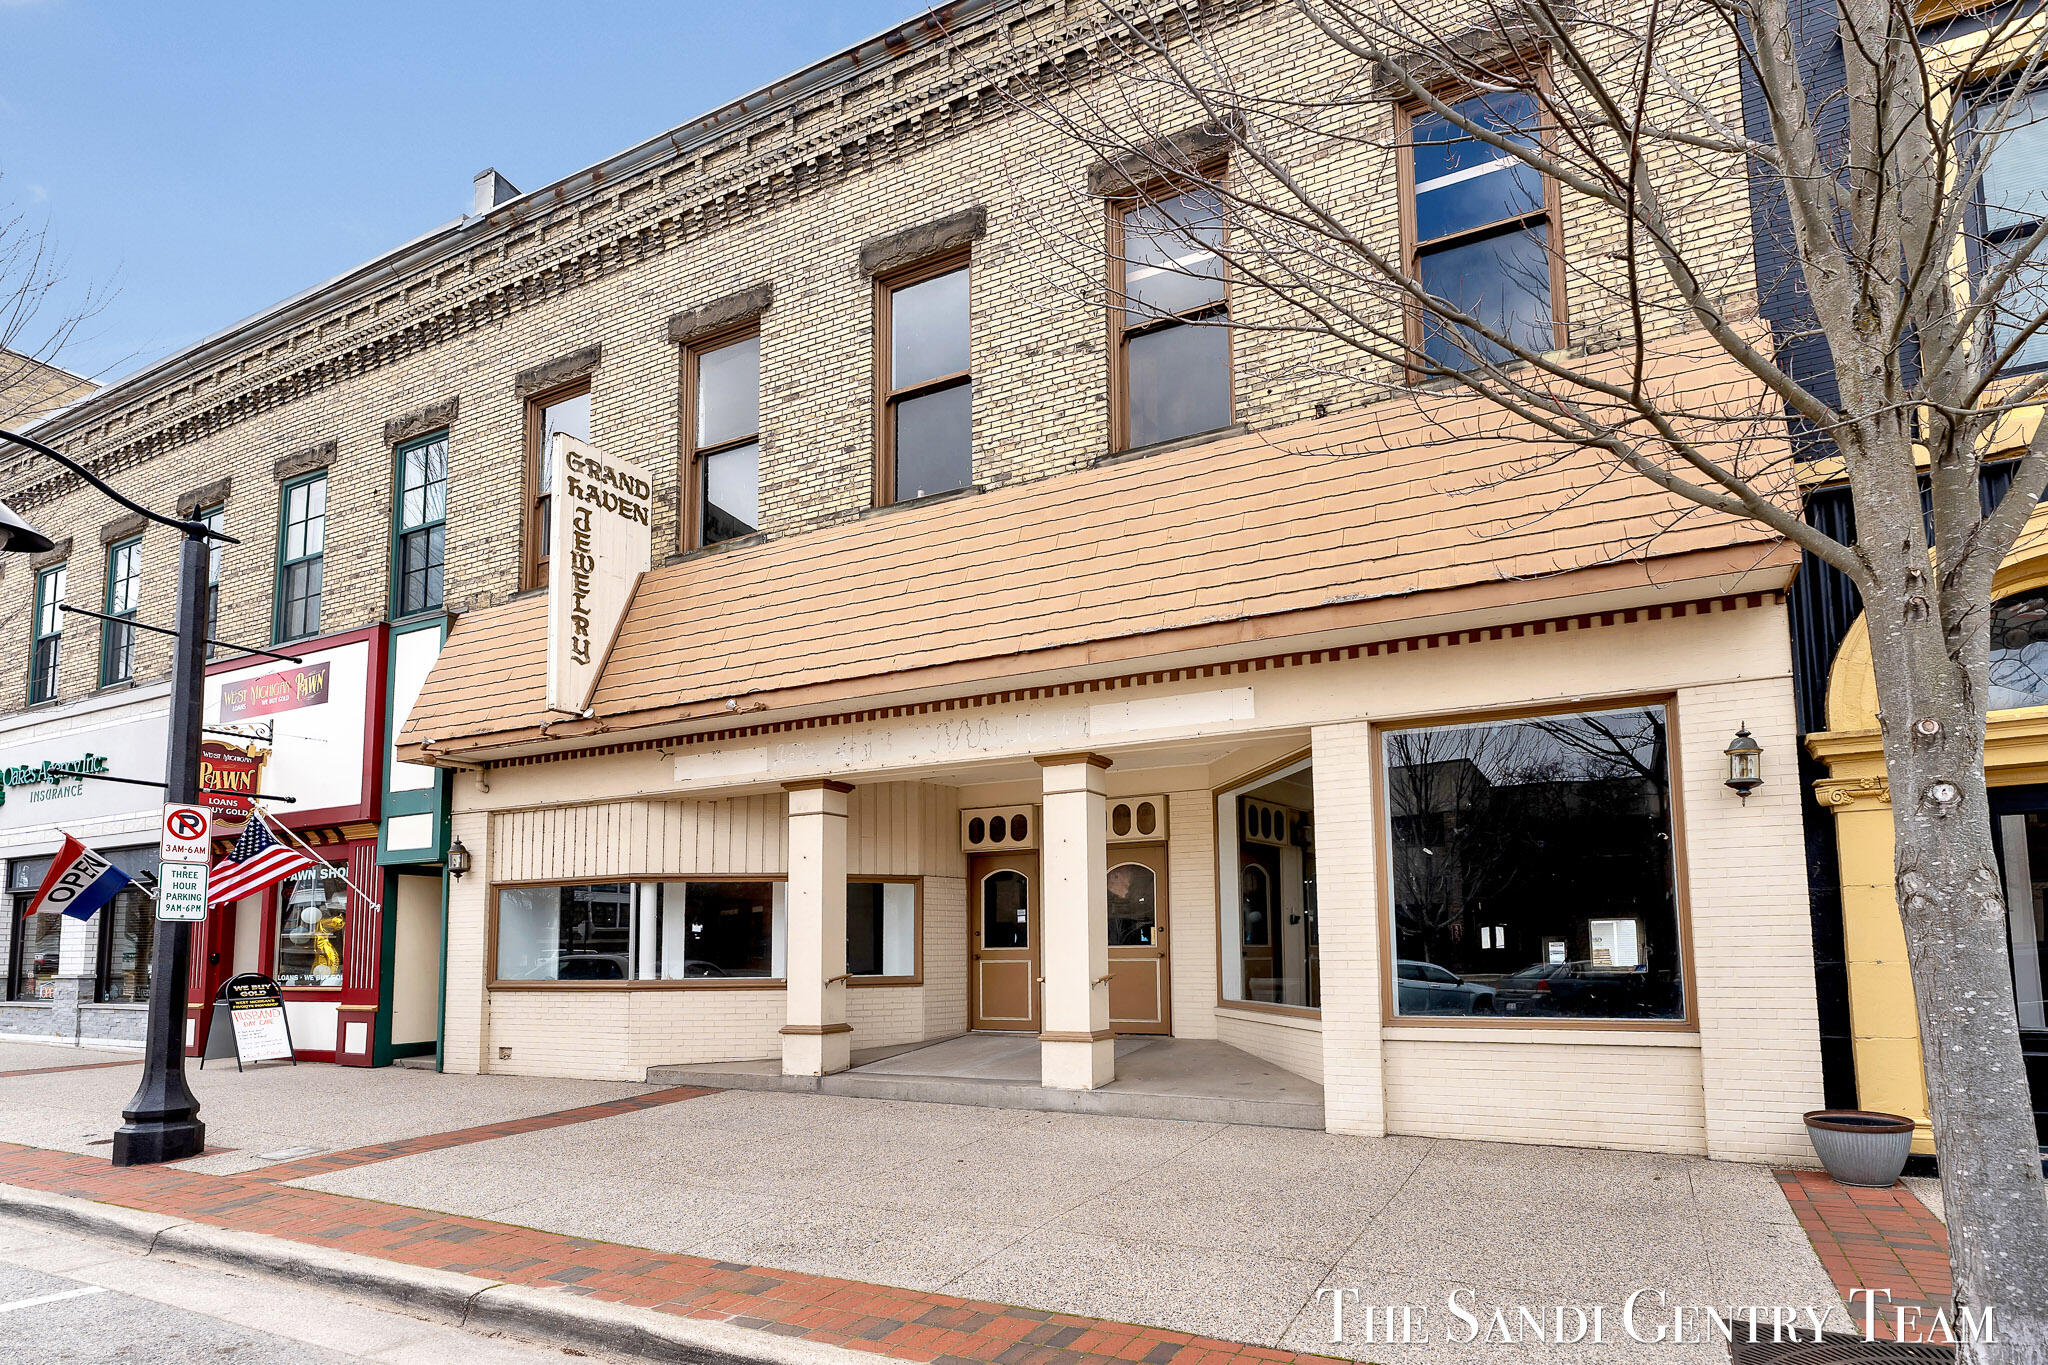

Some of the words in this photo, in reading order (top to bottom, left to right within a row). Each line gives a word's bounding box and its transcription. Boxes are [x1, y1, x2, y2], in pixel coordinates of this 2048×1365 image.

[566, 450, 650, 501] GRAND
[570, 506, 595, 667] JEWELRY
[224, 688, 247, 706] WEST
[250, 681, 291, 706] MICHIGAN
[295, 668, 326, 702] PAWN
[203, 751, 221, 759] WEST
[223, 754, 252, 763] MICHIGAN
[199, 761, 256, 791] PAWN
[30, 783, 83, 803] INSURANCE
[208, 797, 238, 807] LOANS
[211, 806, 224, 815] UY
[225, 808, 249, 817] GOLD
[47, 853, 107, 903] OPEN
[171, 870, 199, 880] THREE
[172, 881, 197, 891] HOUR
[165, 892, 202, 902] PARKING
[165, 903, 201, 912] 9AM-6PM
[233, 984, 250, 992] WE
[251, 983, 272, 991] BUY
[233, 1008, 281, 1022] HUSBAND
